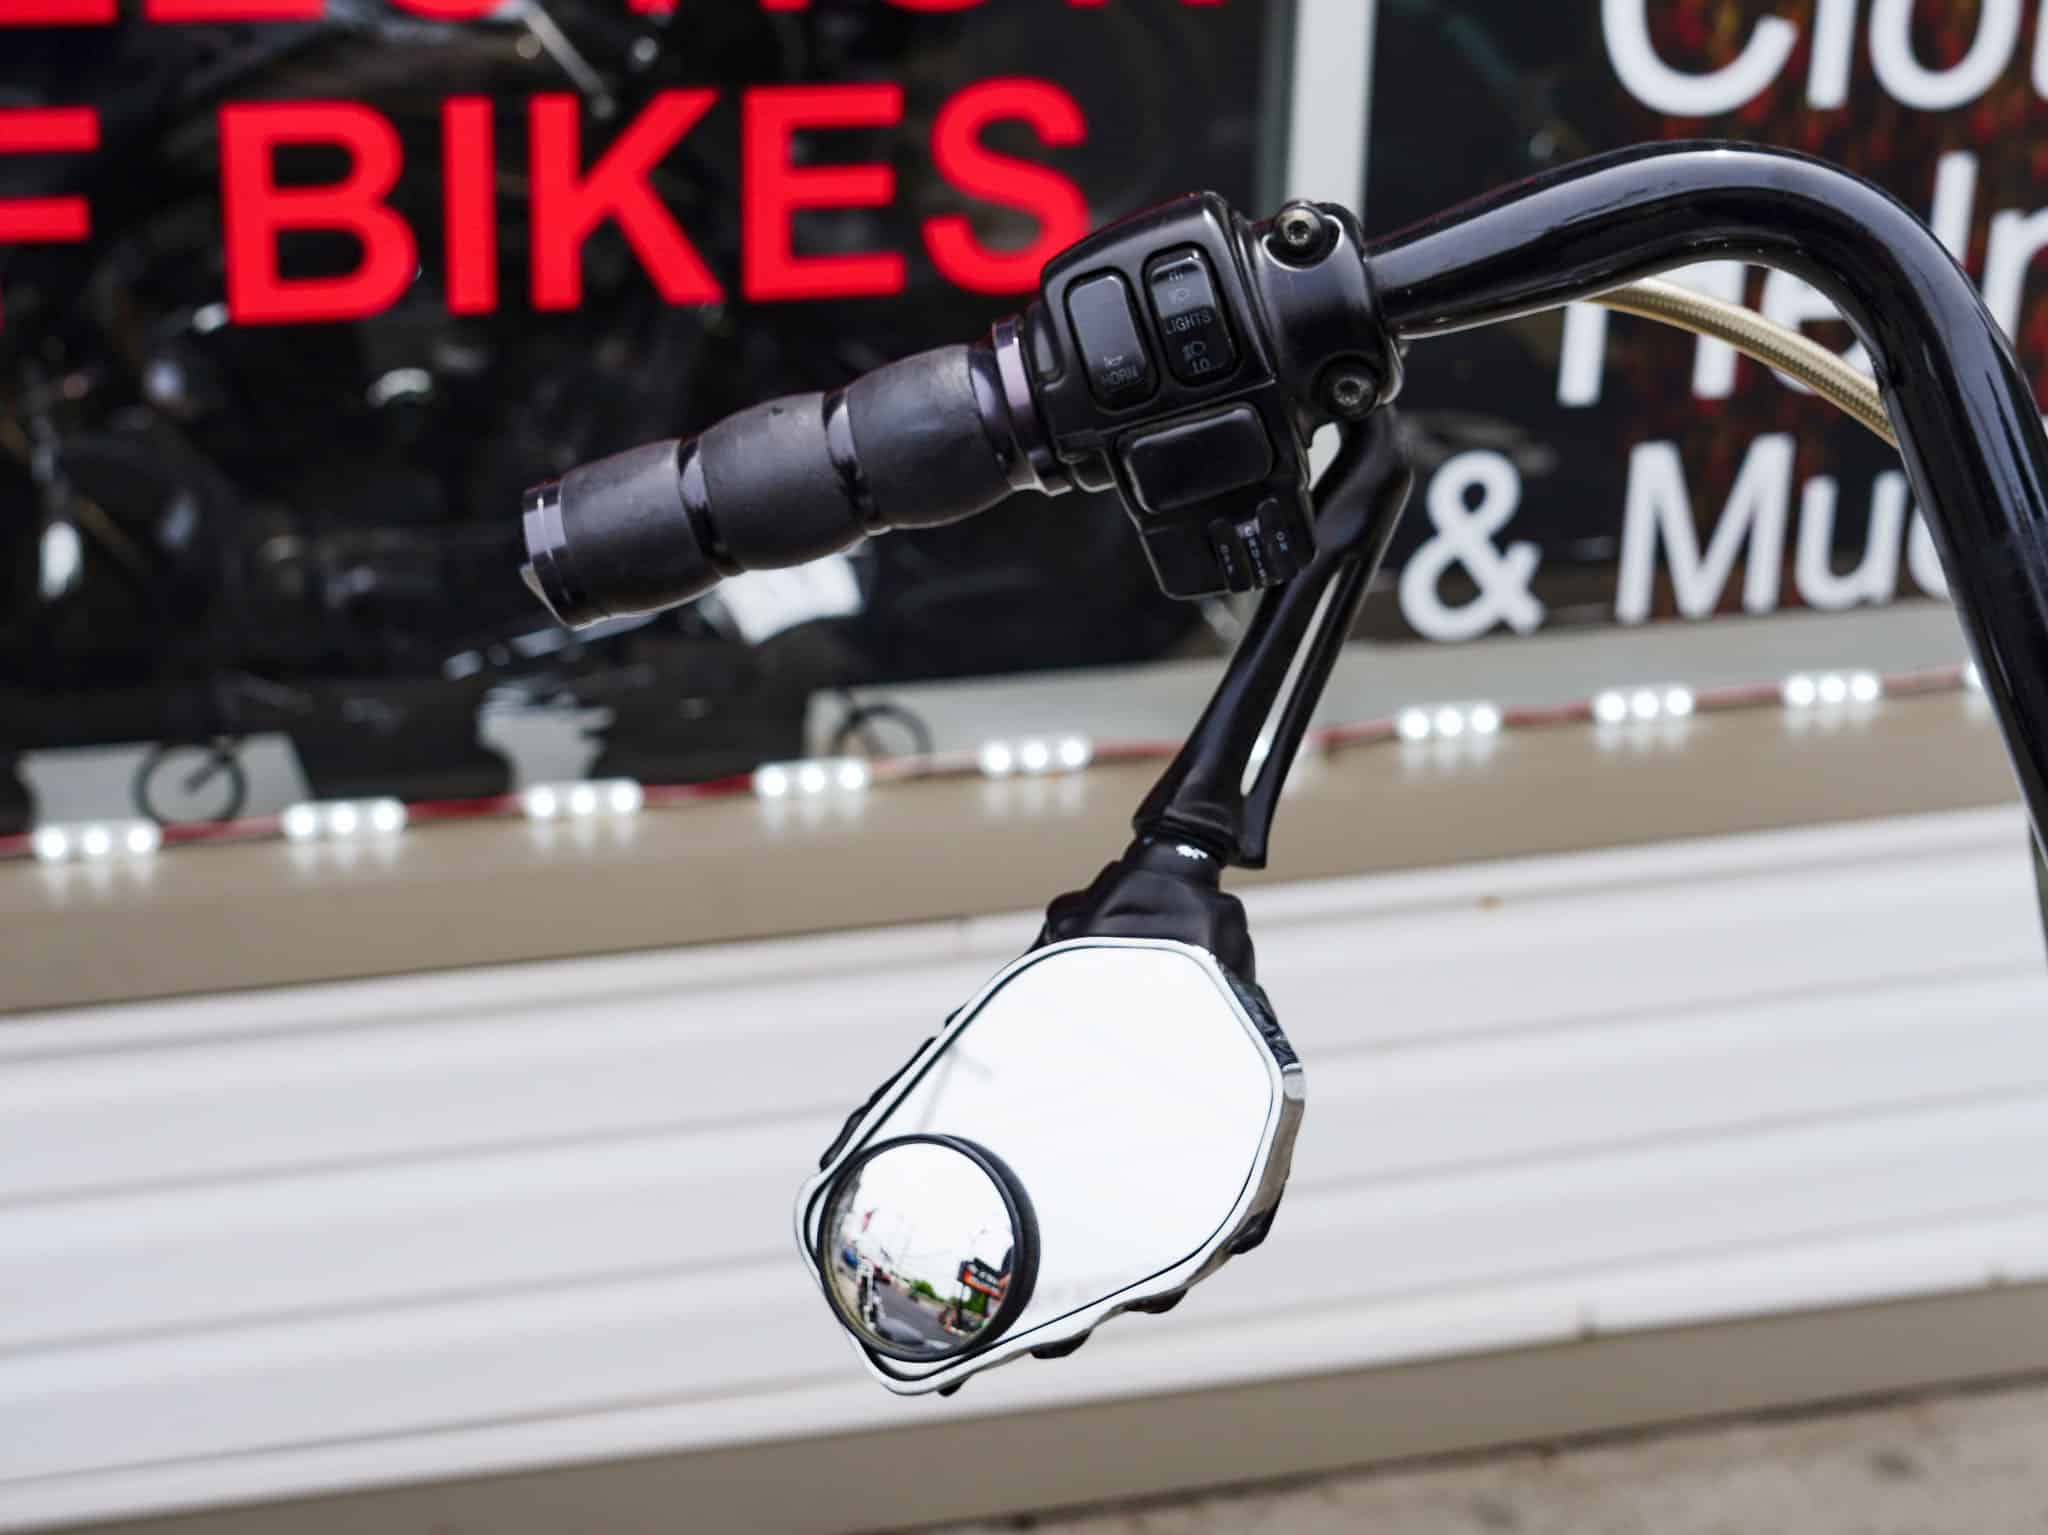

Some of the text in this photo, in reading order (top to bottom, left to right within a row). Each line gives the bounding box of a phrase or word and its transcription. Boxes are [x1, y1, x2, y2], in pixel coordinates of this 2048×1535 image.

[1602, 0, 2048, 117] Clo
[218, 76, 1093, 326] BIKES
[1103, 365, 1140, 386] HORN
[1166, 309, 1213, 336] LIGHTS
[1399, 449, 1546, 643] &
